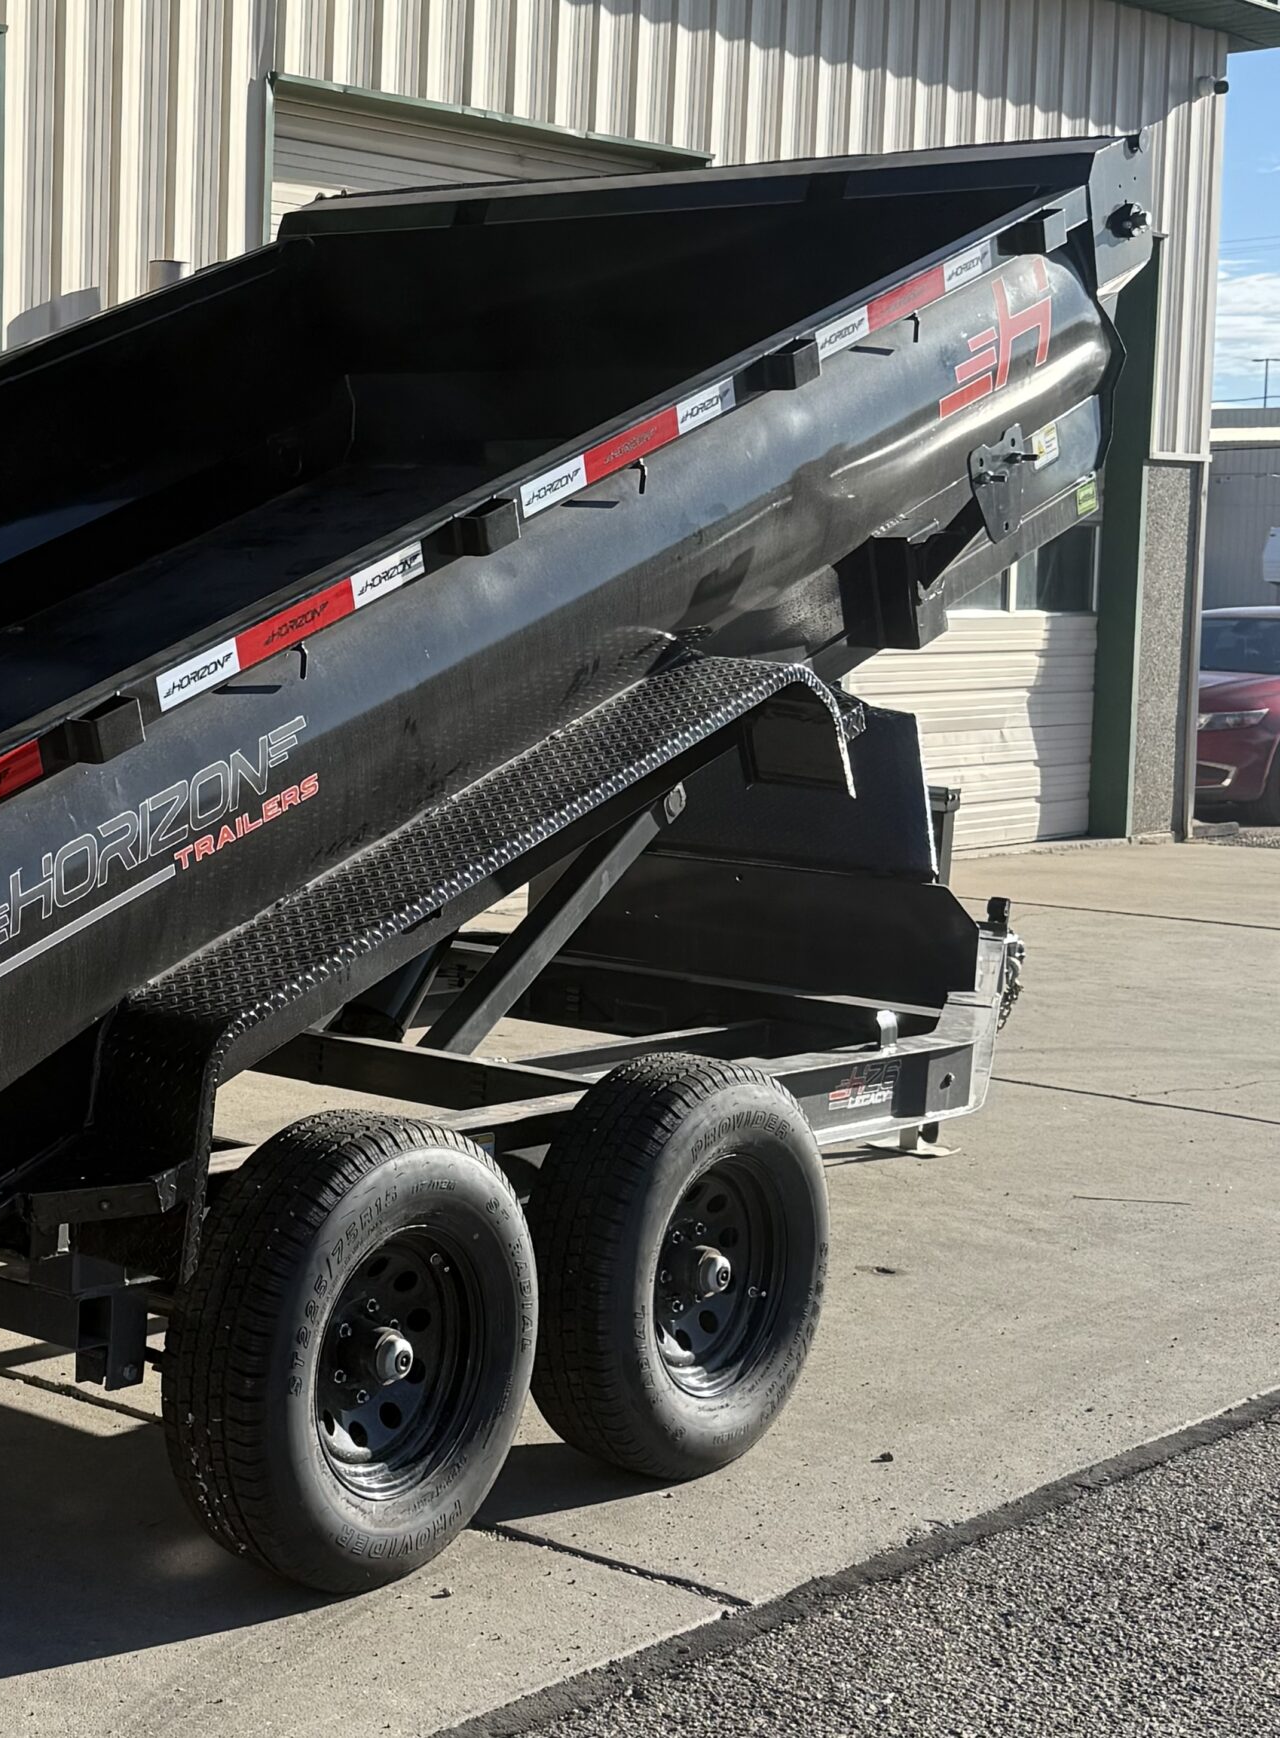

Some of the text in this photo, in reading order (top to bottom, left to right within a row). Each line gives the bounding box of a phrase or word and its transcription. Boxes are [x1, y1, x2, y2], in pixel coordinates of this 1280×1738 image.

[531, 472, 575, 502] HORIZON
[363, 556, 413, 593] HORIZON
[270, 606, 321, 642] HORIZON
[170, 656, 225, 694] HORIZON
[10, 735, 269, 938] HORIZON
[174, 773, 319, 869] TRAILERS
[691, 1110, 791, 1164] PROVIDER
[336, 1499, 463, 1559] PROVIDER
